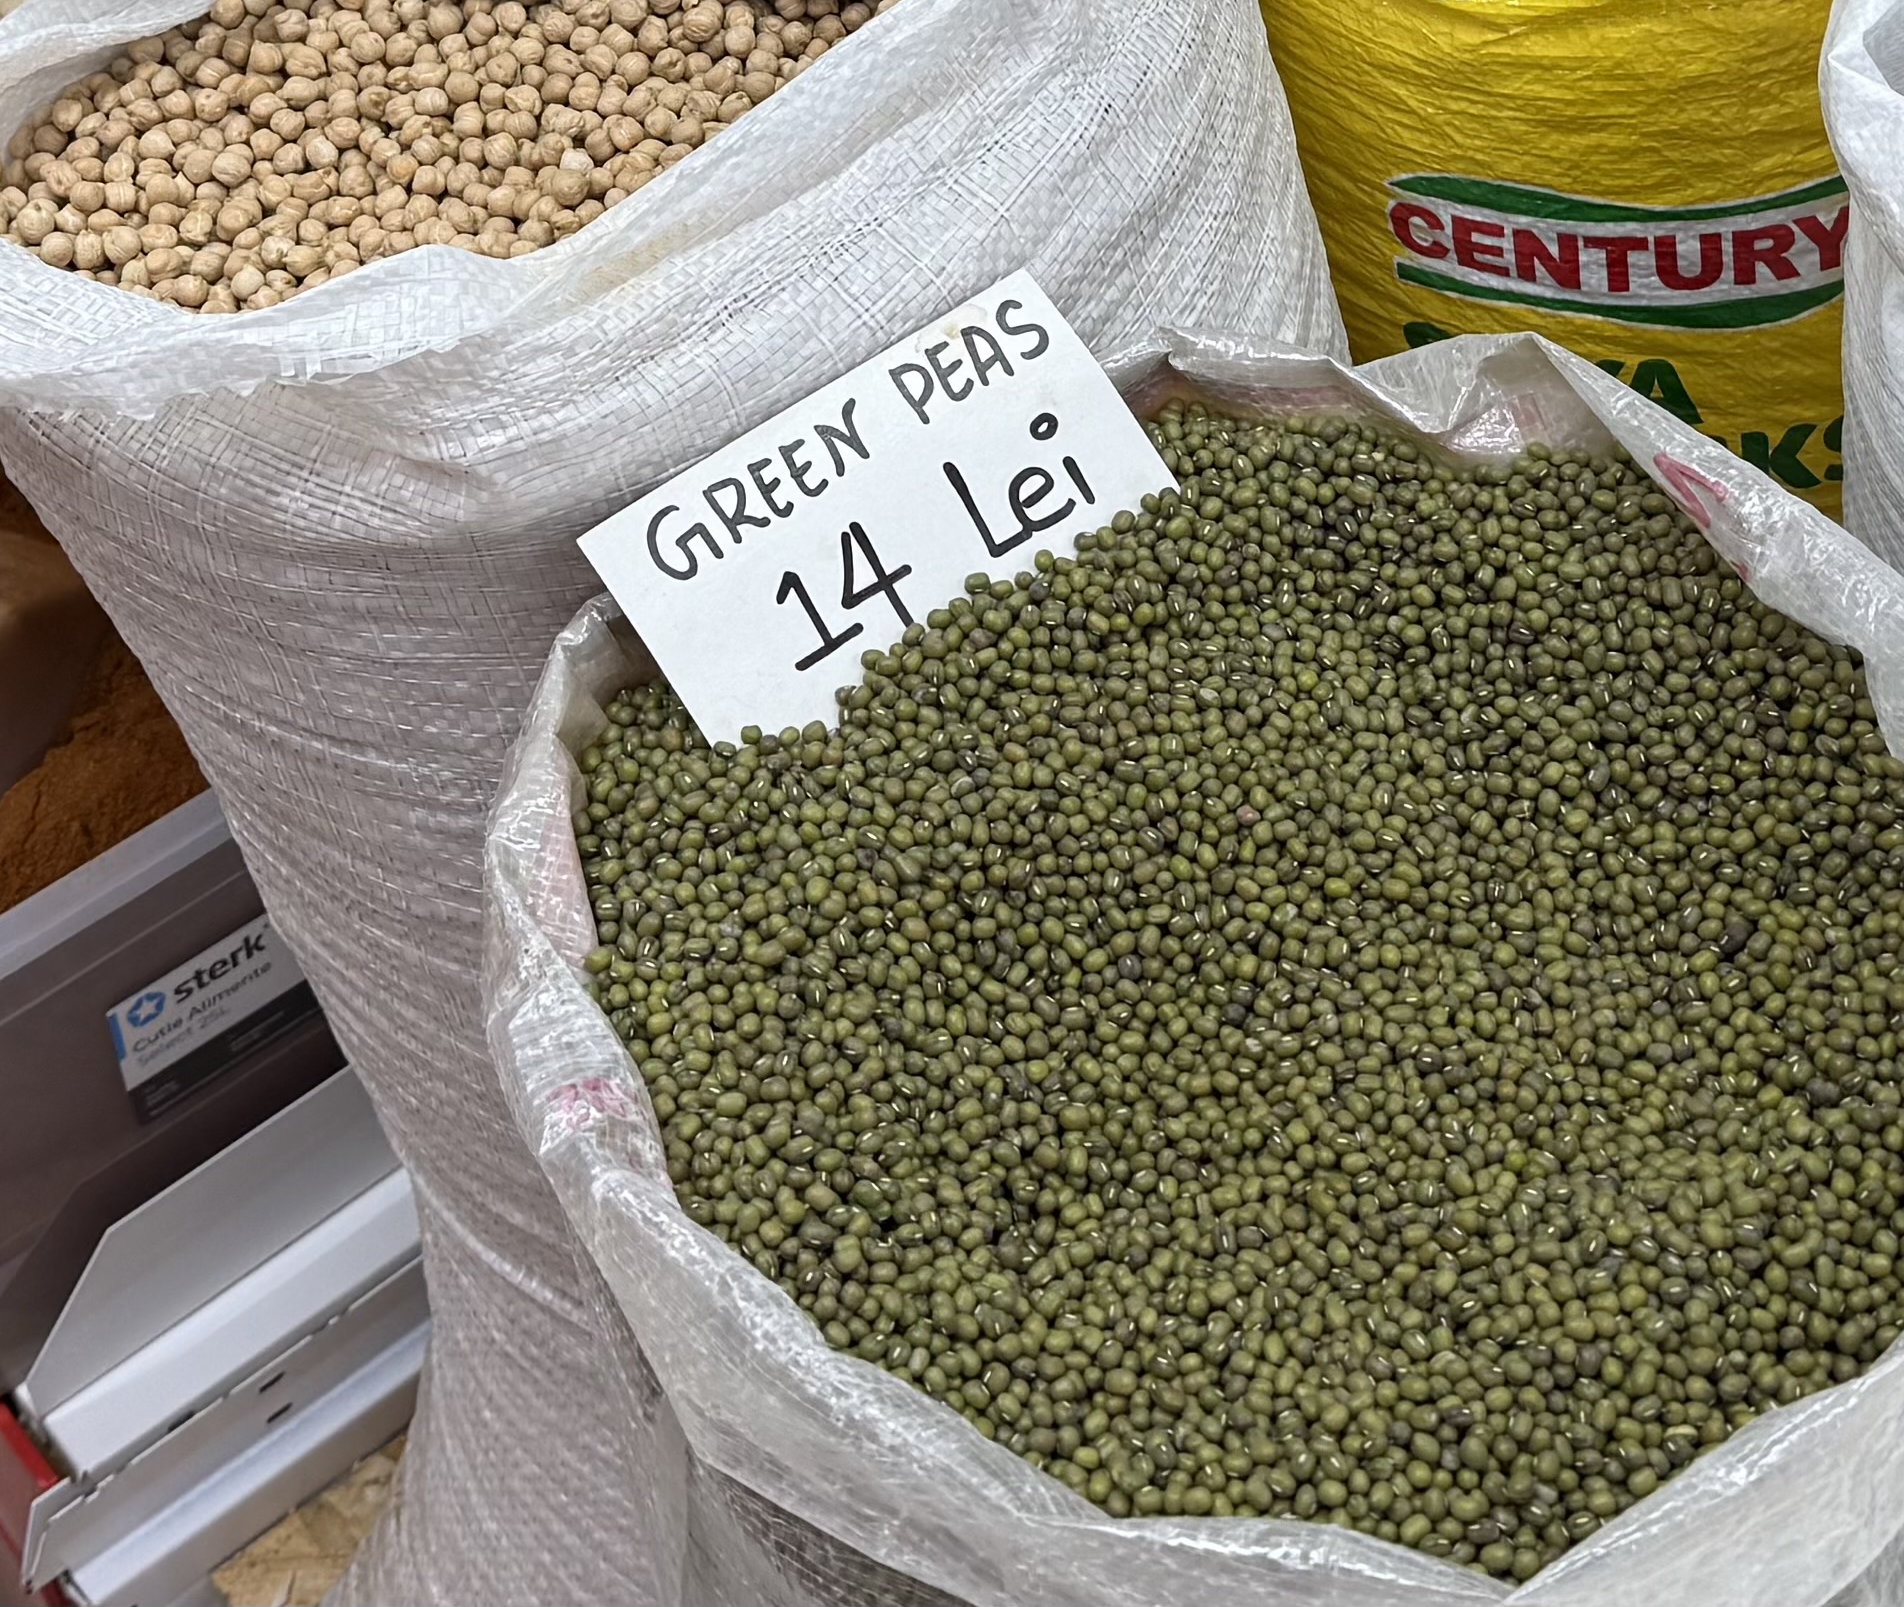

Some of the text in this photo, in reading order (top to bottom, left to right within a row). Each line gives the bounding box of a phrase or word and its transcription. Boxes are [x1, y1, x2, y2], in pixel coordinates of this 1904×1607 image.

[1389, 202, 1850, 294] CENTURY
[645, 299, 1050, 581] GREEN PEAS
[776, 411, 1096, 671] 14 Lei
[173, 933, 267, 1005] sterk
